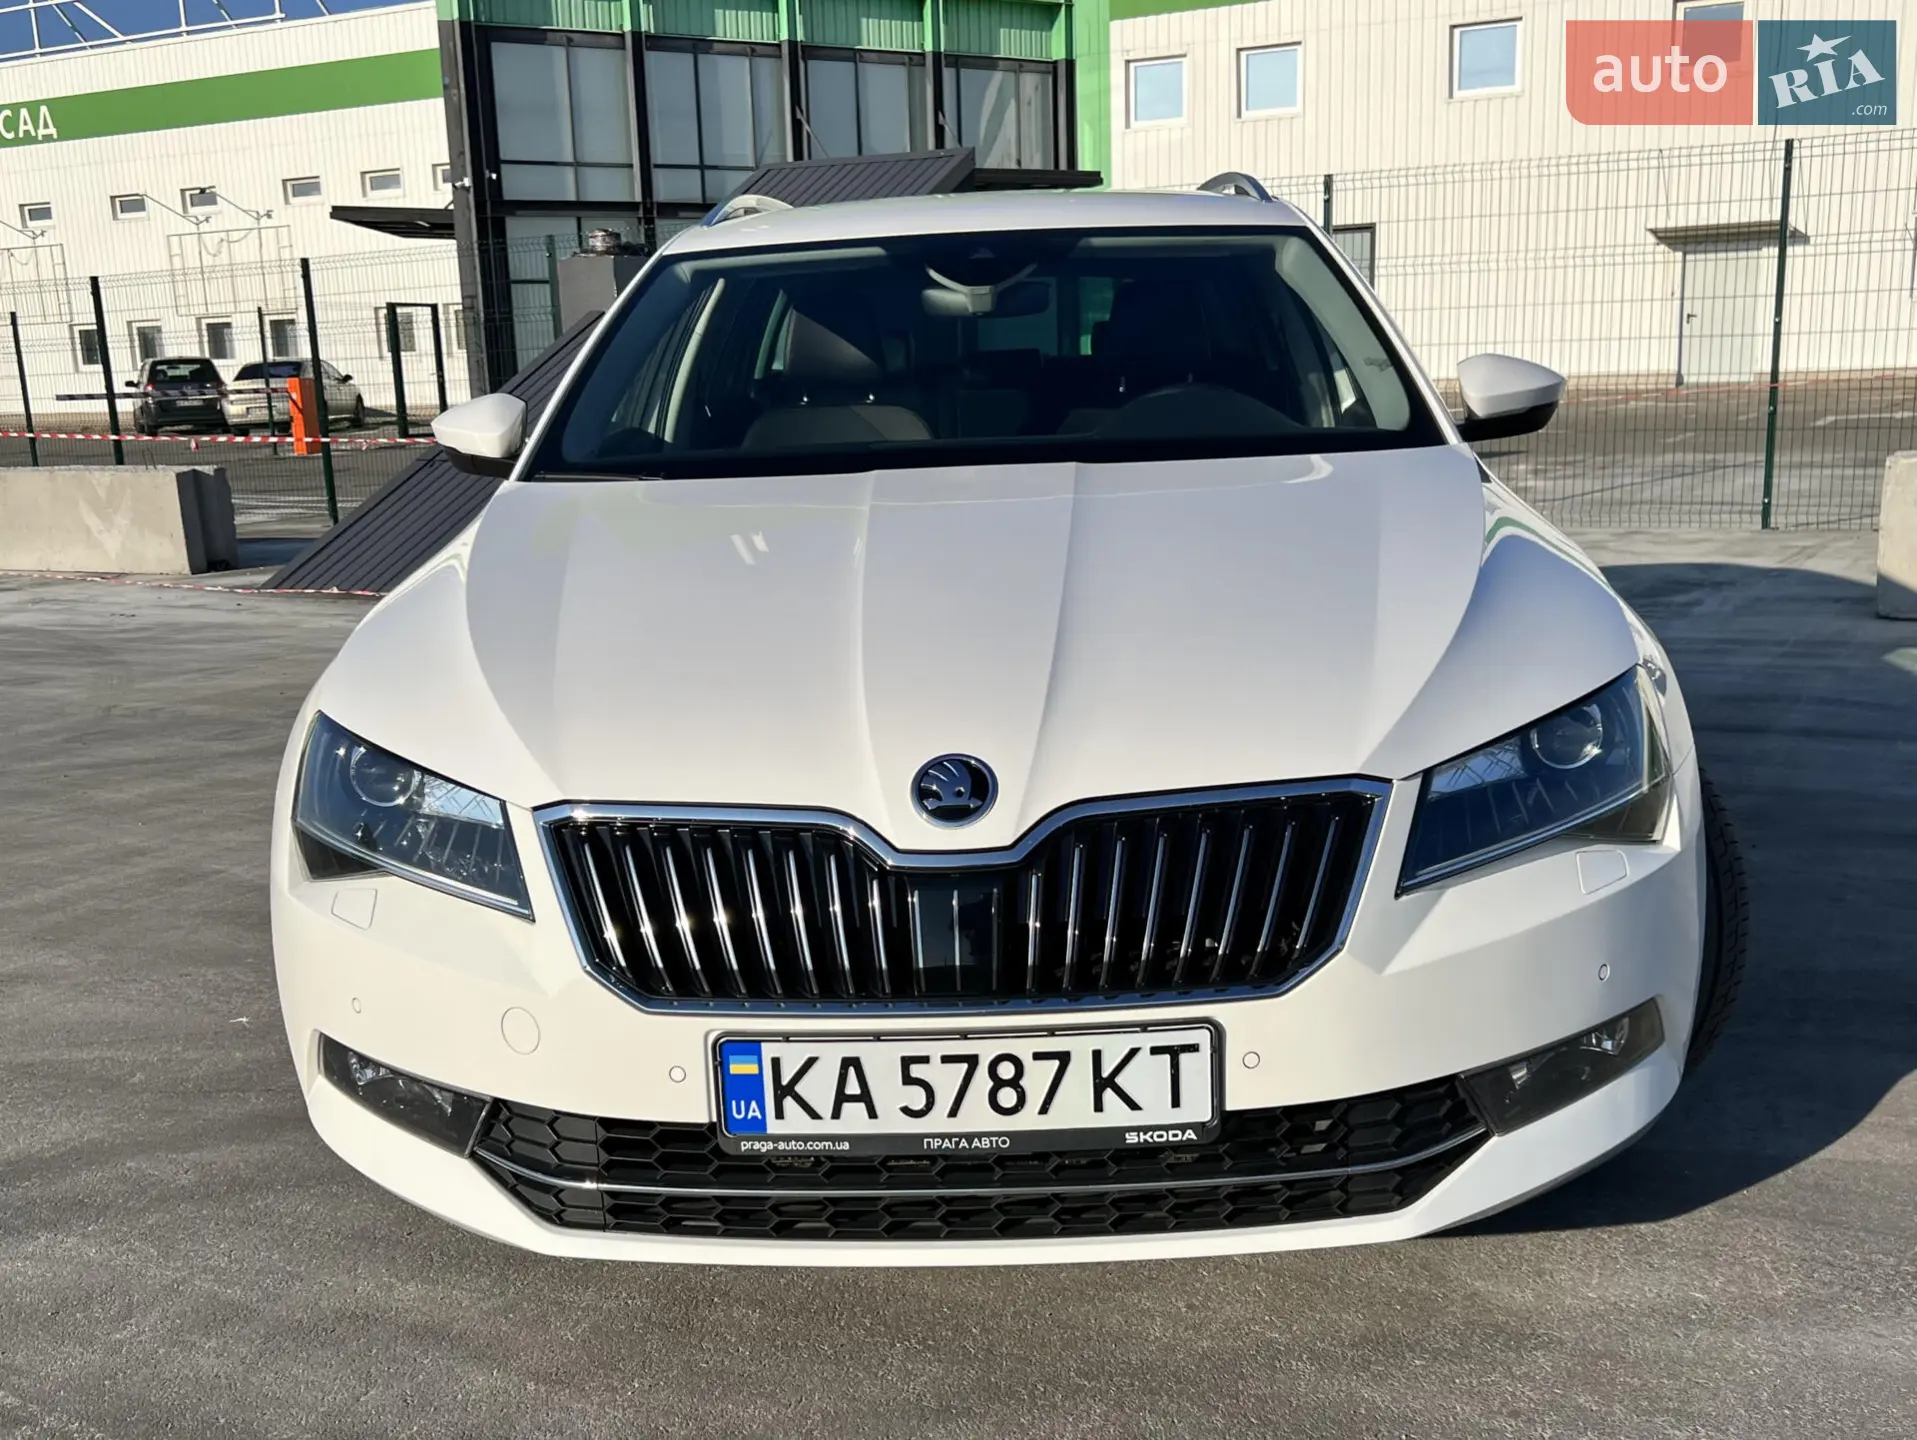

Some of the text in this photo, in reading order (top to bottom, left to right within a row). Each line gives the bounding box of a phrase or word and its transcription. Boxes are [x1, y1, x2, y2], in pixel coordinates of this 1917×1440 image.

[0, 105, 58, 141] САД
[899, 1050, 1071, 1119] 5787
[732, 1100, 762, 1120] UA
[740, 1138, 850, 1152] praga-auto.com.ua
[923, 1136, 1011, 1149] ПРАГА АВТО
